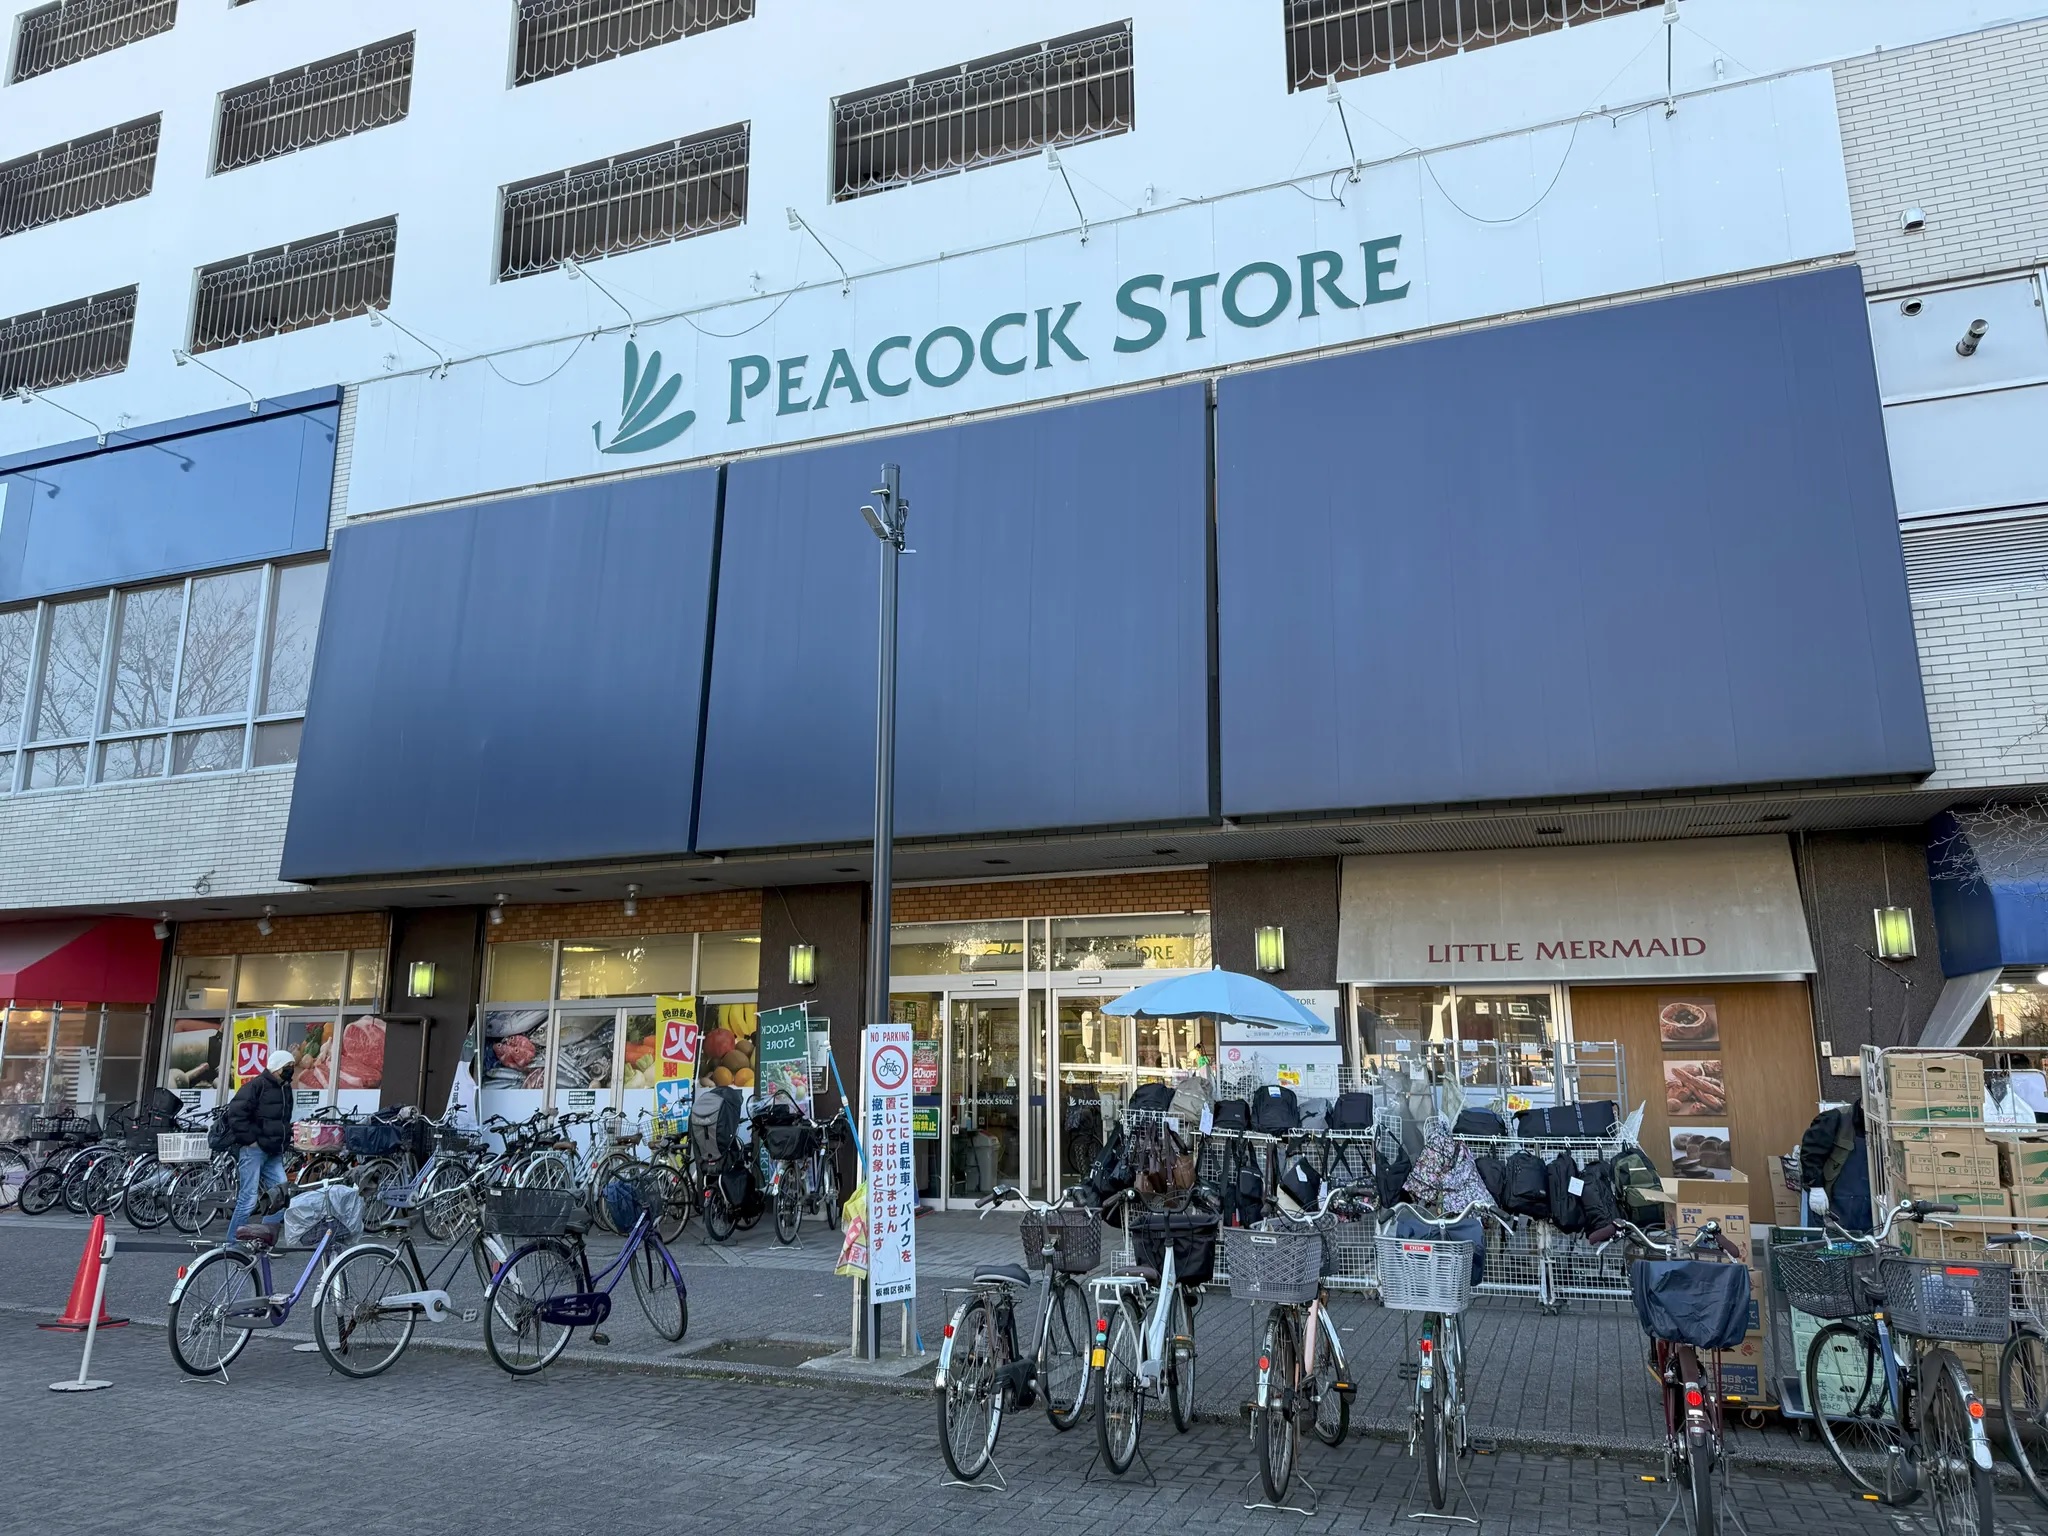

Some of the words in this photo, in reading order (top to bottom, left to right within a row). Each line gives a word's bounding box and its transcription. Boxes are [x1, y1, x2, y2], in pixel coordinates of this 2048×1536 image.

[727, 301, 1090, 425] PEACOCK
[1113, 234, 1411, 353] STORE
[1427, 942, 1524, 963] LITTLE
[1535, 937, 1707, 961] MERMAID
[870, 1032, 879, 1043] NO
[882, 1031, 910, 1042] PARKING
[1229, 1050, 1240, 1060] 2F
[968, 1098, 994, 1106] PEACOCK
[995, 1098, 1014, 1106] STORE
[871, 1097, 884, 1251] 撤去の対象となります
[885, 1096, 898, 1234] 置いてはいけません
[899, 1096, 912, 1264] ここに自転車・バイクを
[875, 1284, 912, 1297] 板橋区役所
